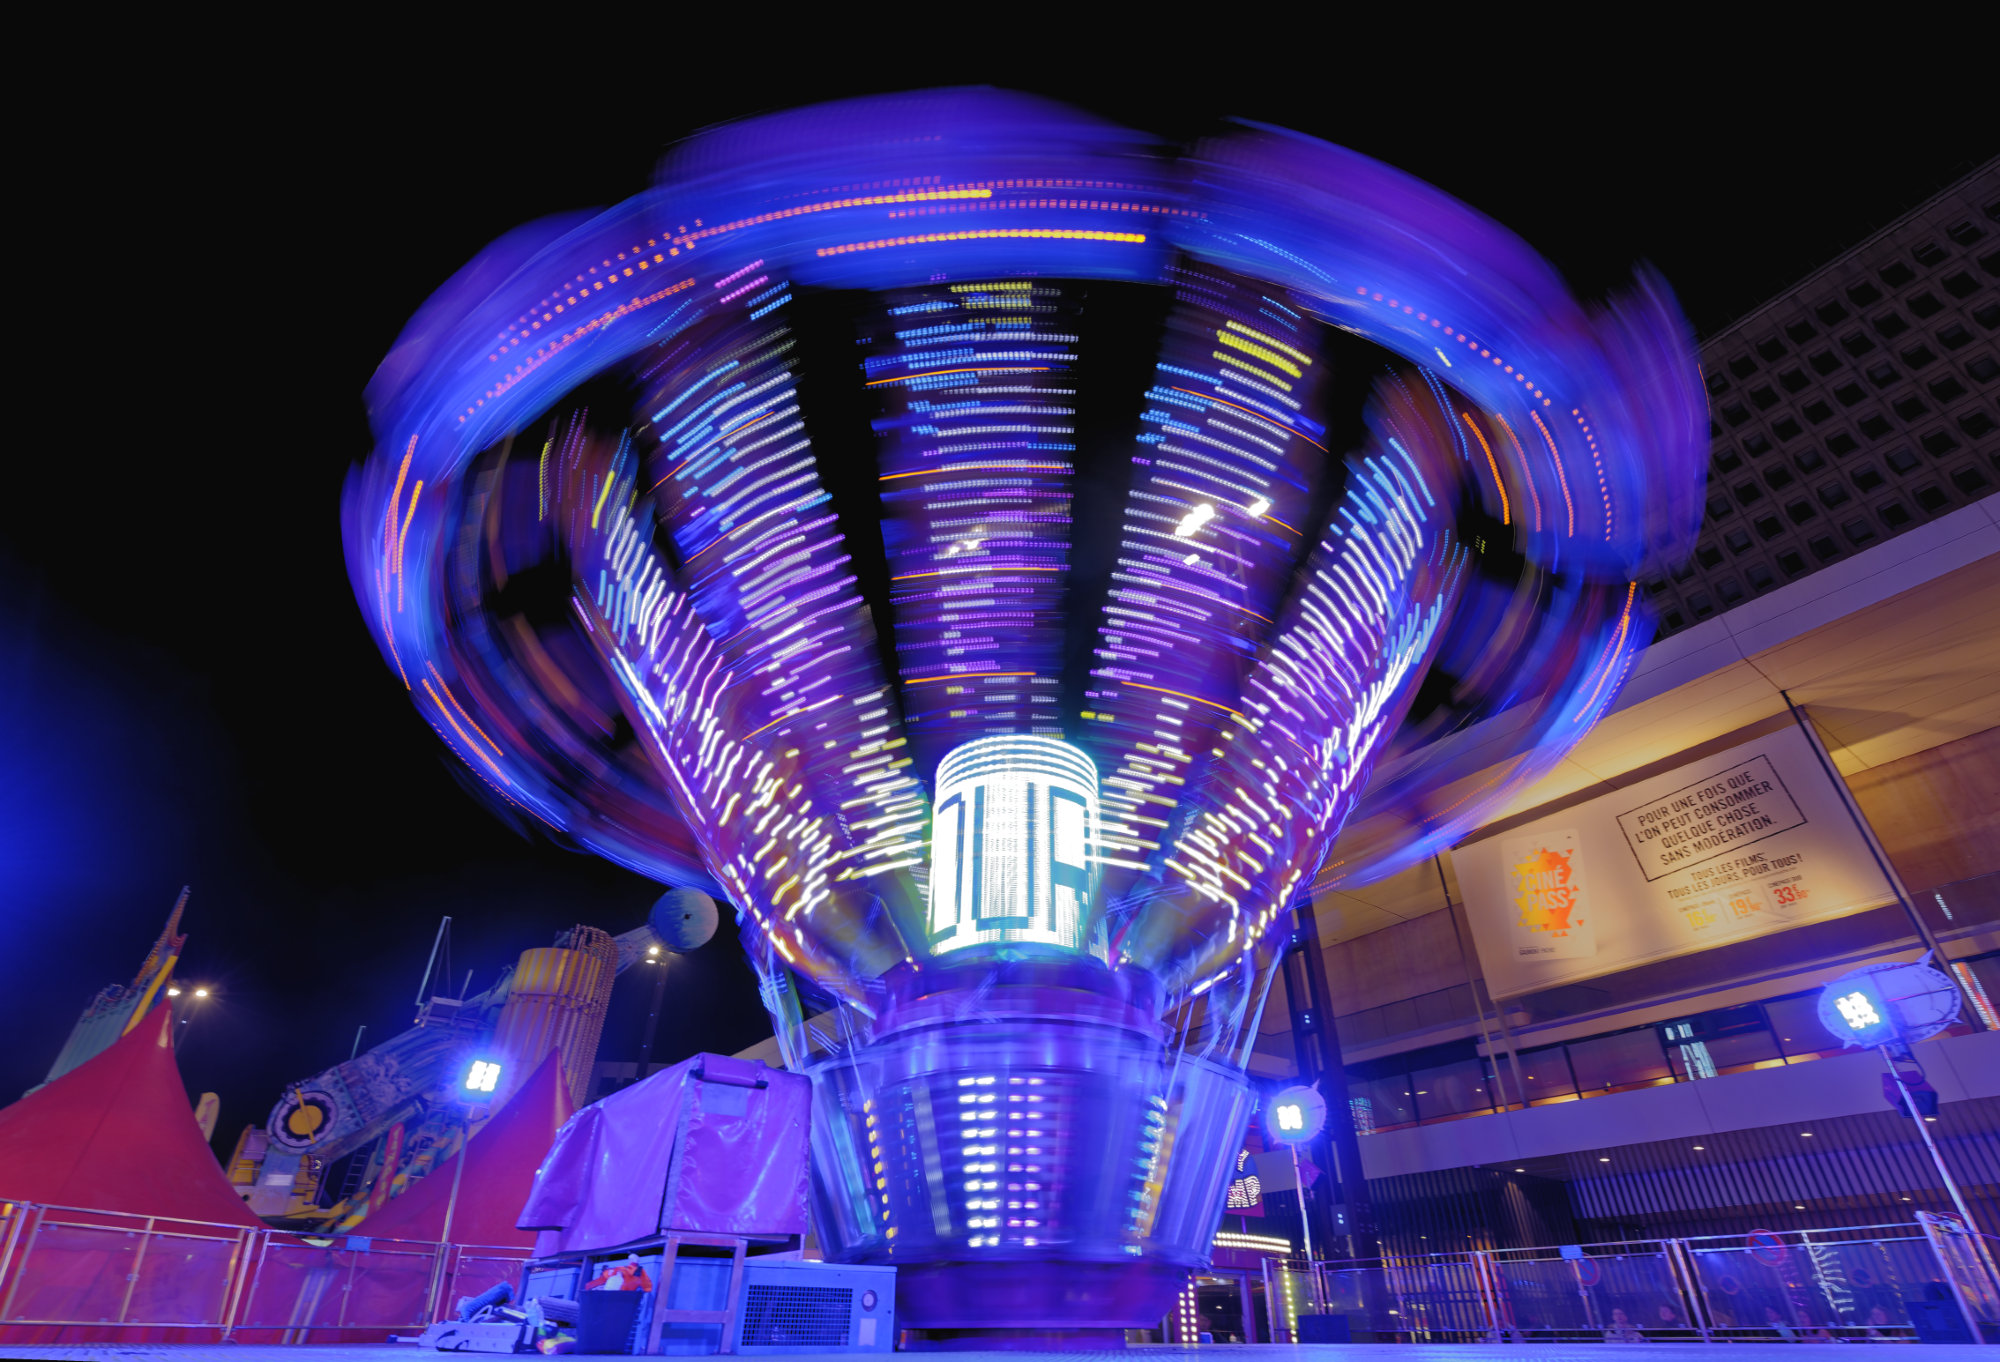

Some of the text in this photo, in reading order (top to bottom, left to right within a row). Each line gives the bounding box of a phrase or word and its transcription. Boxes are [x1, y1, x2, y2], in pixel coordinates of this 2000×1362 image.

[1635, 780, 1774, 844] L'ON PEUT CONSOMMER
[1637, 771, 1755, 826] POUR UNE FOIS QUE
[1661, 802, 1761, 849] QUELQUE CHOSE
[1660, 845, 1693, 866] SANS
[1525, 864, 1567, 892] CINÉ
[1666, 885, 1691, 899] TOUS
[1691, 880, 1711, 893] LES
[1742, 863, 1770, 878] POUR
[1690, 867, 1716, 882] TOUS
[1716, 862, 1734, 874] LES
[1527, 889, 1569, 912] PASS
